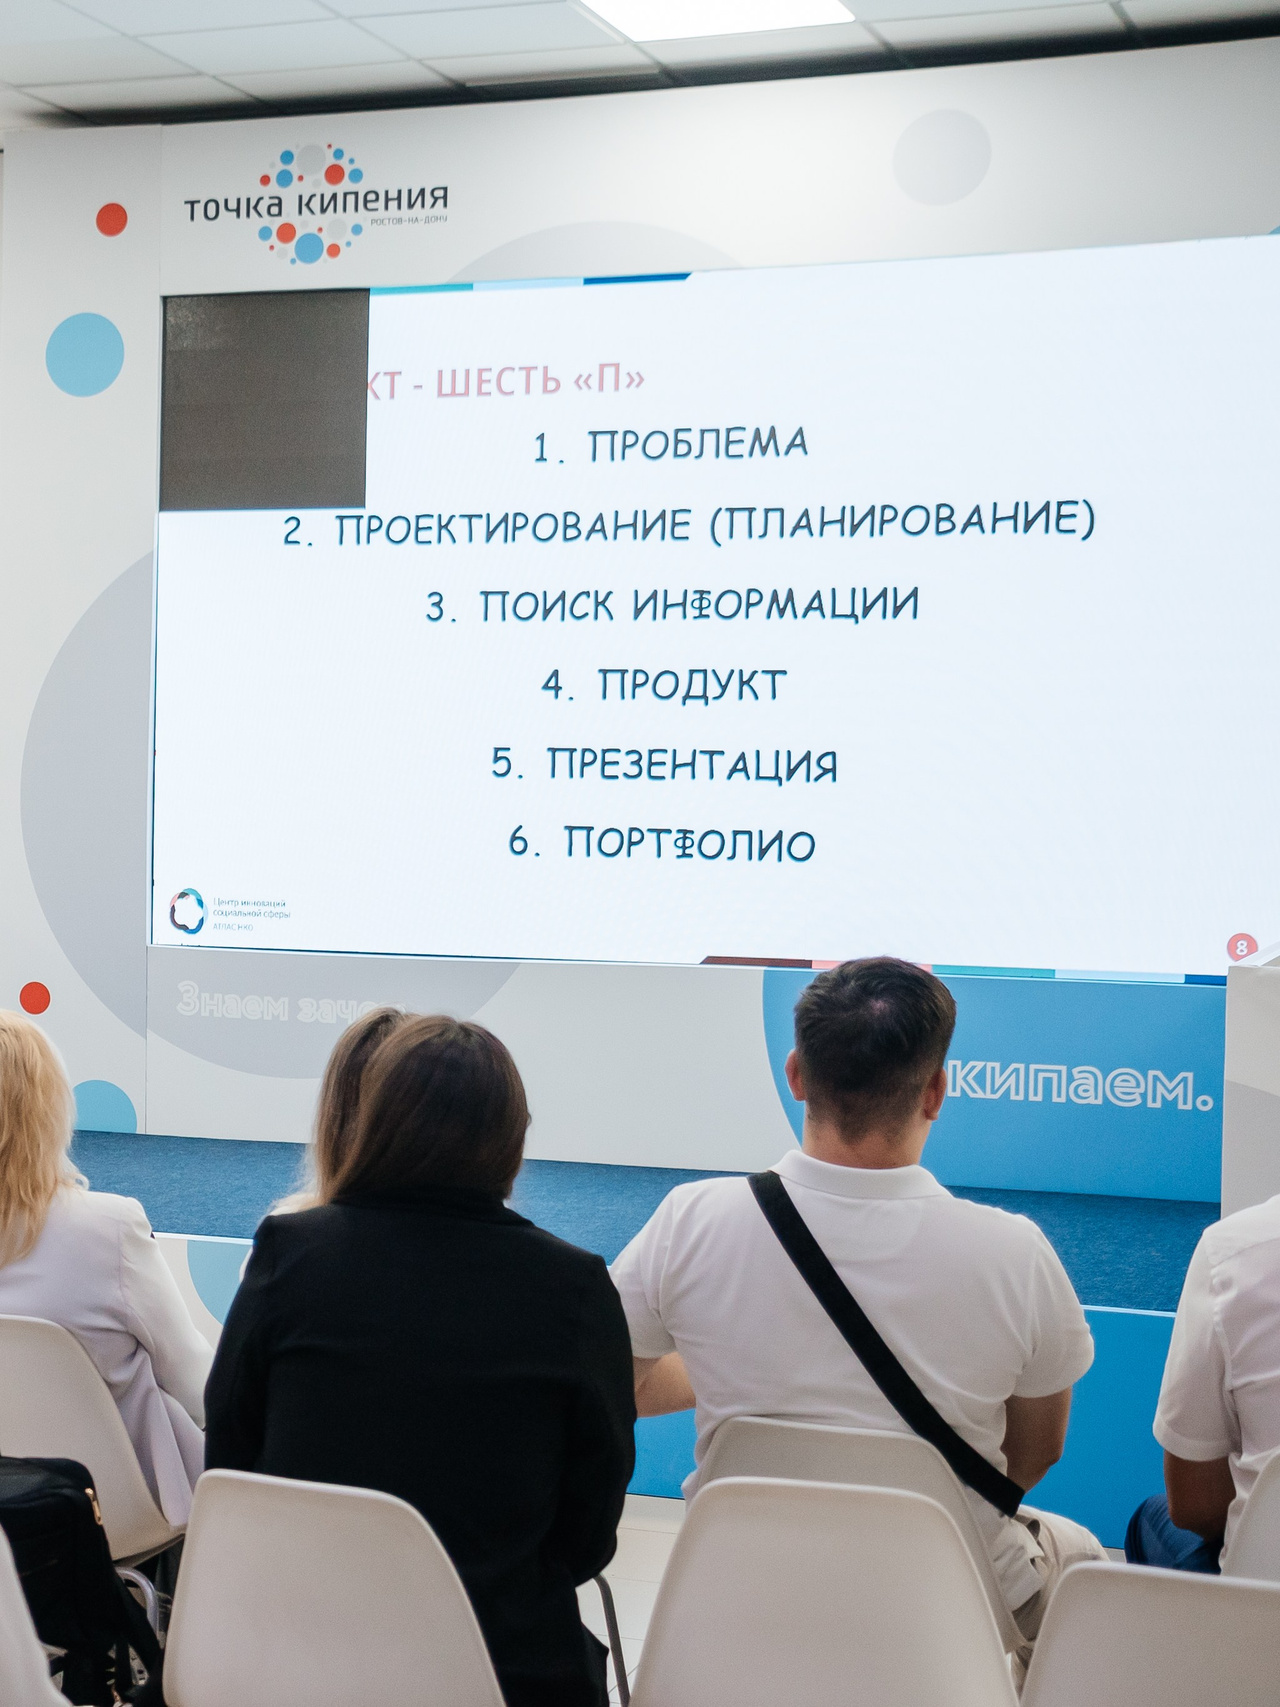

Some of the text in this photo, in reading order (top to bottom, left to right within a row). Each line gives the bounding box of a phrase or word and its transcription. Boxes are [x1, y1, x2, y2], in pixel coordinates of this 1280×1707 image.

[184, 186, 449, 222] точка кипения
[370, 215, 448, 226] РОСТОВ-НА-ДОНУ
[436, 366, 561, 397] ШЕСТЬ
[573, 362, 645, 393] «П»
[534, 425, 809, 464] 1. ПРОБЛЕМА
[283, 499, 1095, 548] 2. ПРОЕКТИРОВАНИЕ (ПЛАНИРОВАНИЕ)
[426, 586, 919, 625] 3. ПОИСК ИНФОРМАЦИИ
[540, 668, 788, 707] 4. ПРОДУКТ
[491, 746, 837, 788] 5. ПРЕЗЕНТАЦИЯ
[508, 824, 816, 863] 6. ПОРТФОЛИО
[1235, 939, 1248, 956] 8
[176, 980, 407, 1025] Знаем зач
[947, 1060, 1214, 1111] кипаем.
